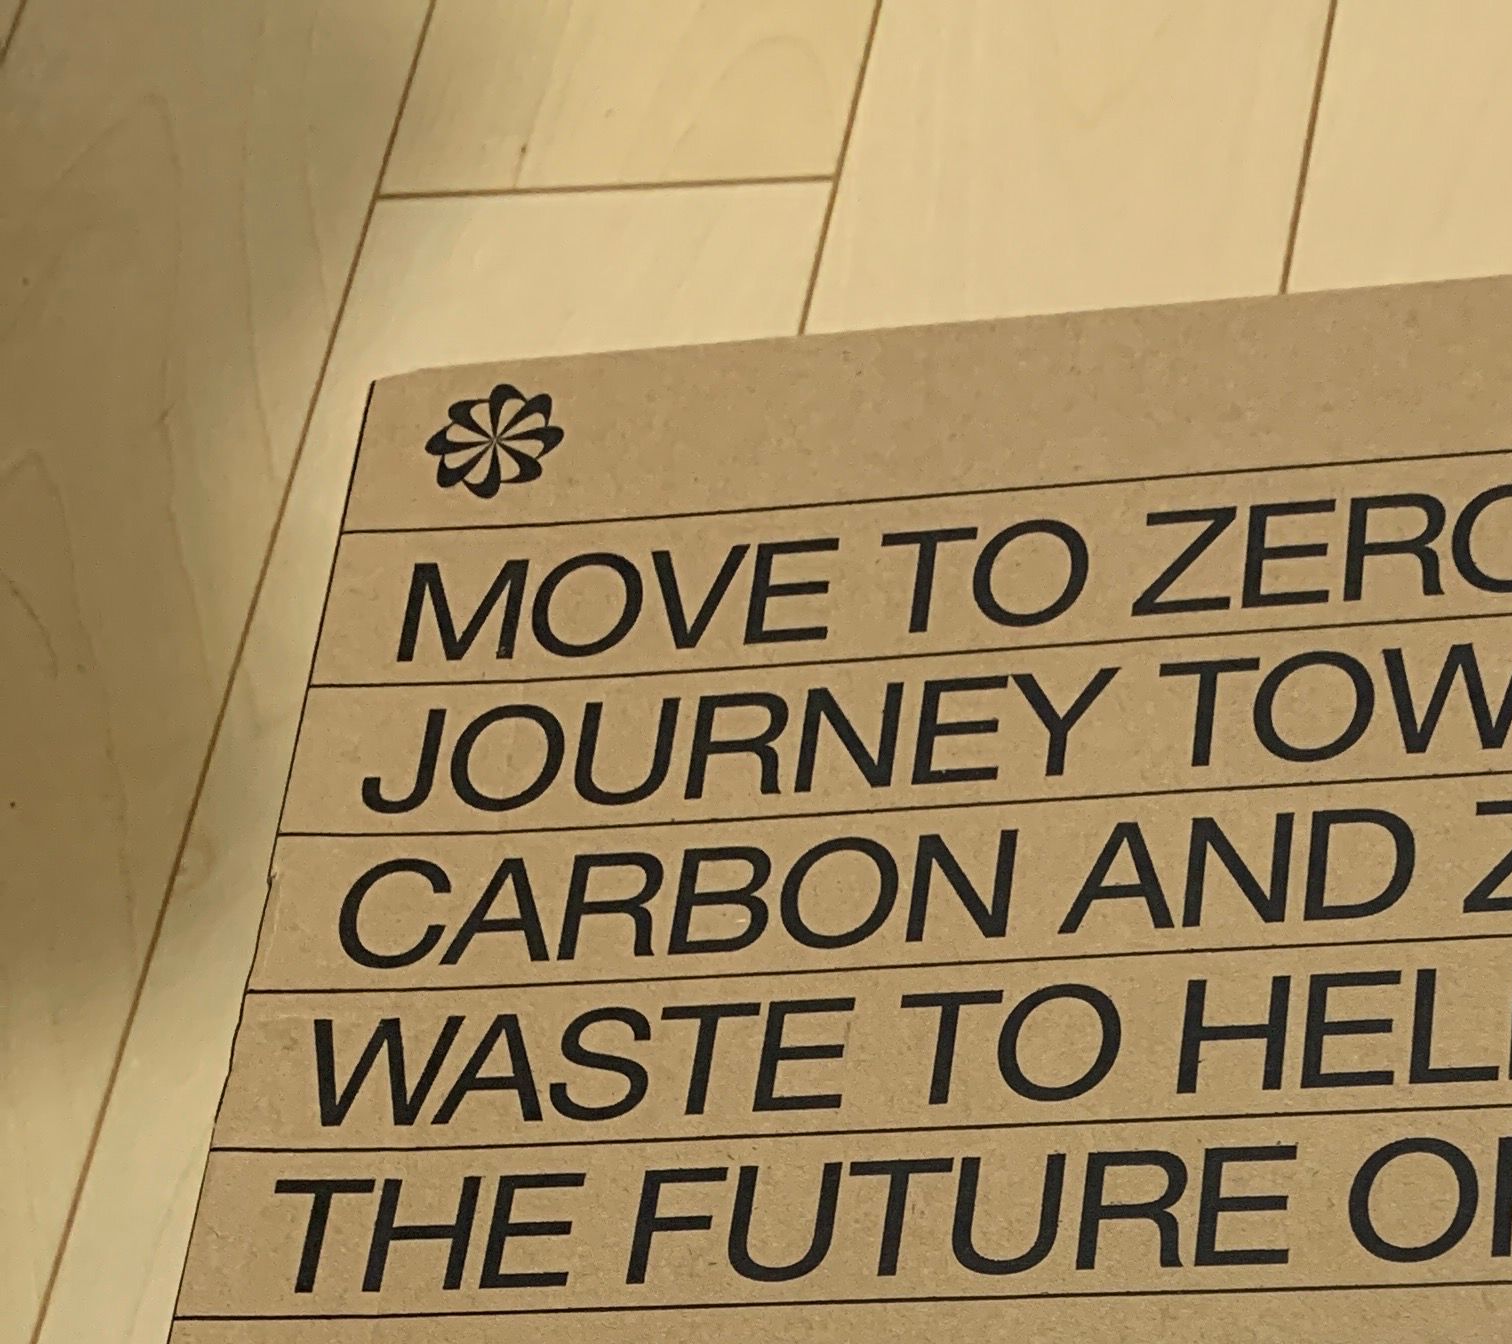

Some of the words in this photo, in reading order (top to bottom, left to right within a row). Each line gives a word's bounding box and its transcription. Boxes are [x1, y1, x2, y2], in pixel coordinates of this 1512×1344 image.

[397, 538, 840, 663] MOVE
[881, 518, 1089, 634] TO
[361, 666, 1122, 815] JOURNEY
[338, 828, 1019, 970] CARBON
[1057, 808, 1416, 935] AND
[313, 996, 857, 1127] WASTE
[900, 961, 1122, 1106] TO
[273, 1172, 587, 1294] THE
[625, 1144, 1298, 1285] FUTURE
